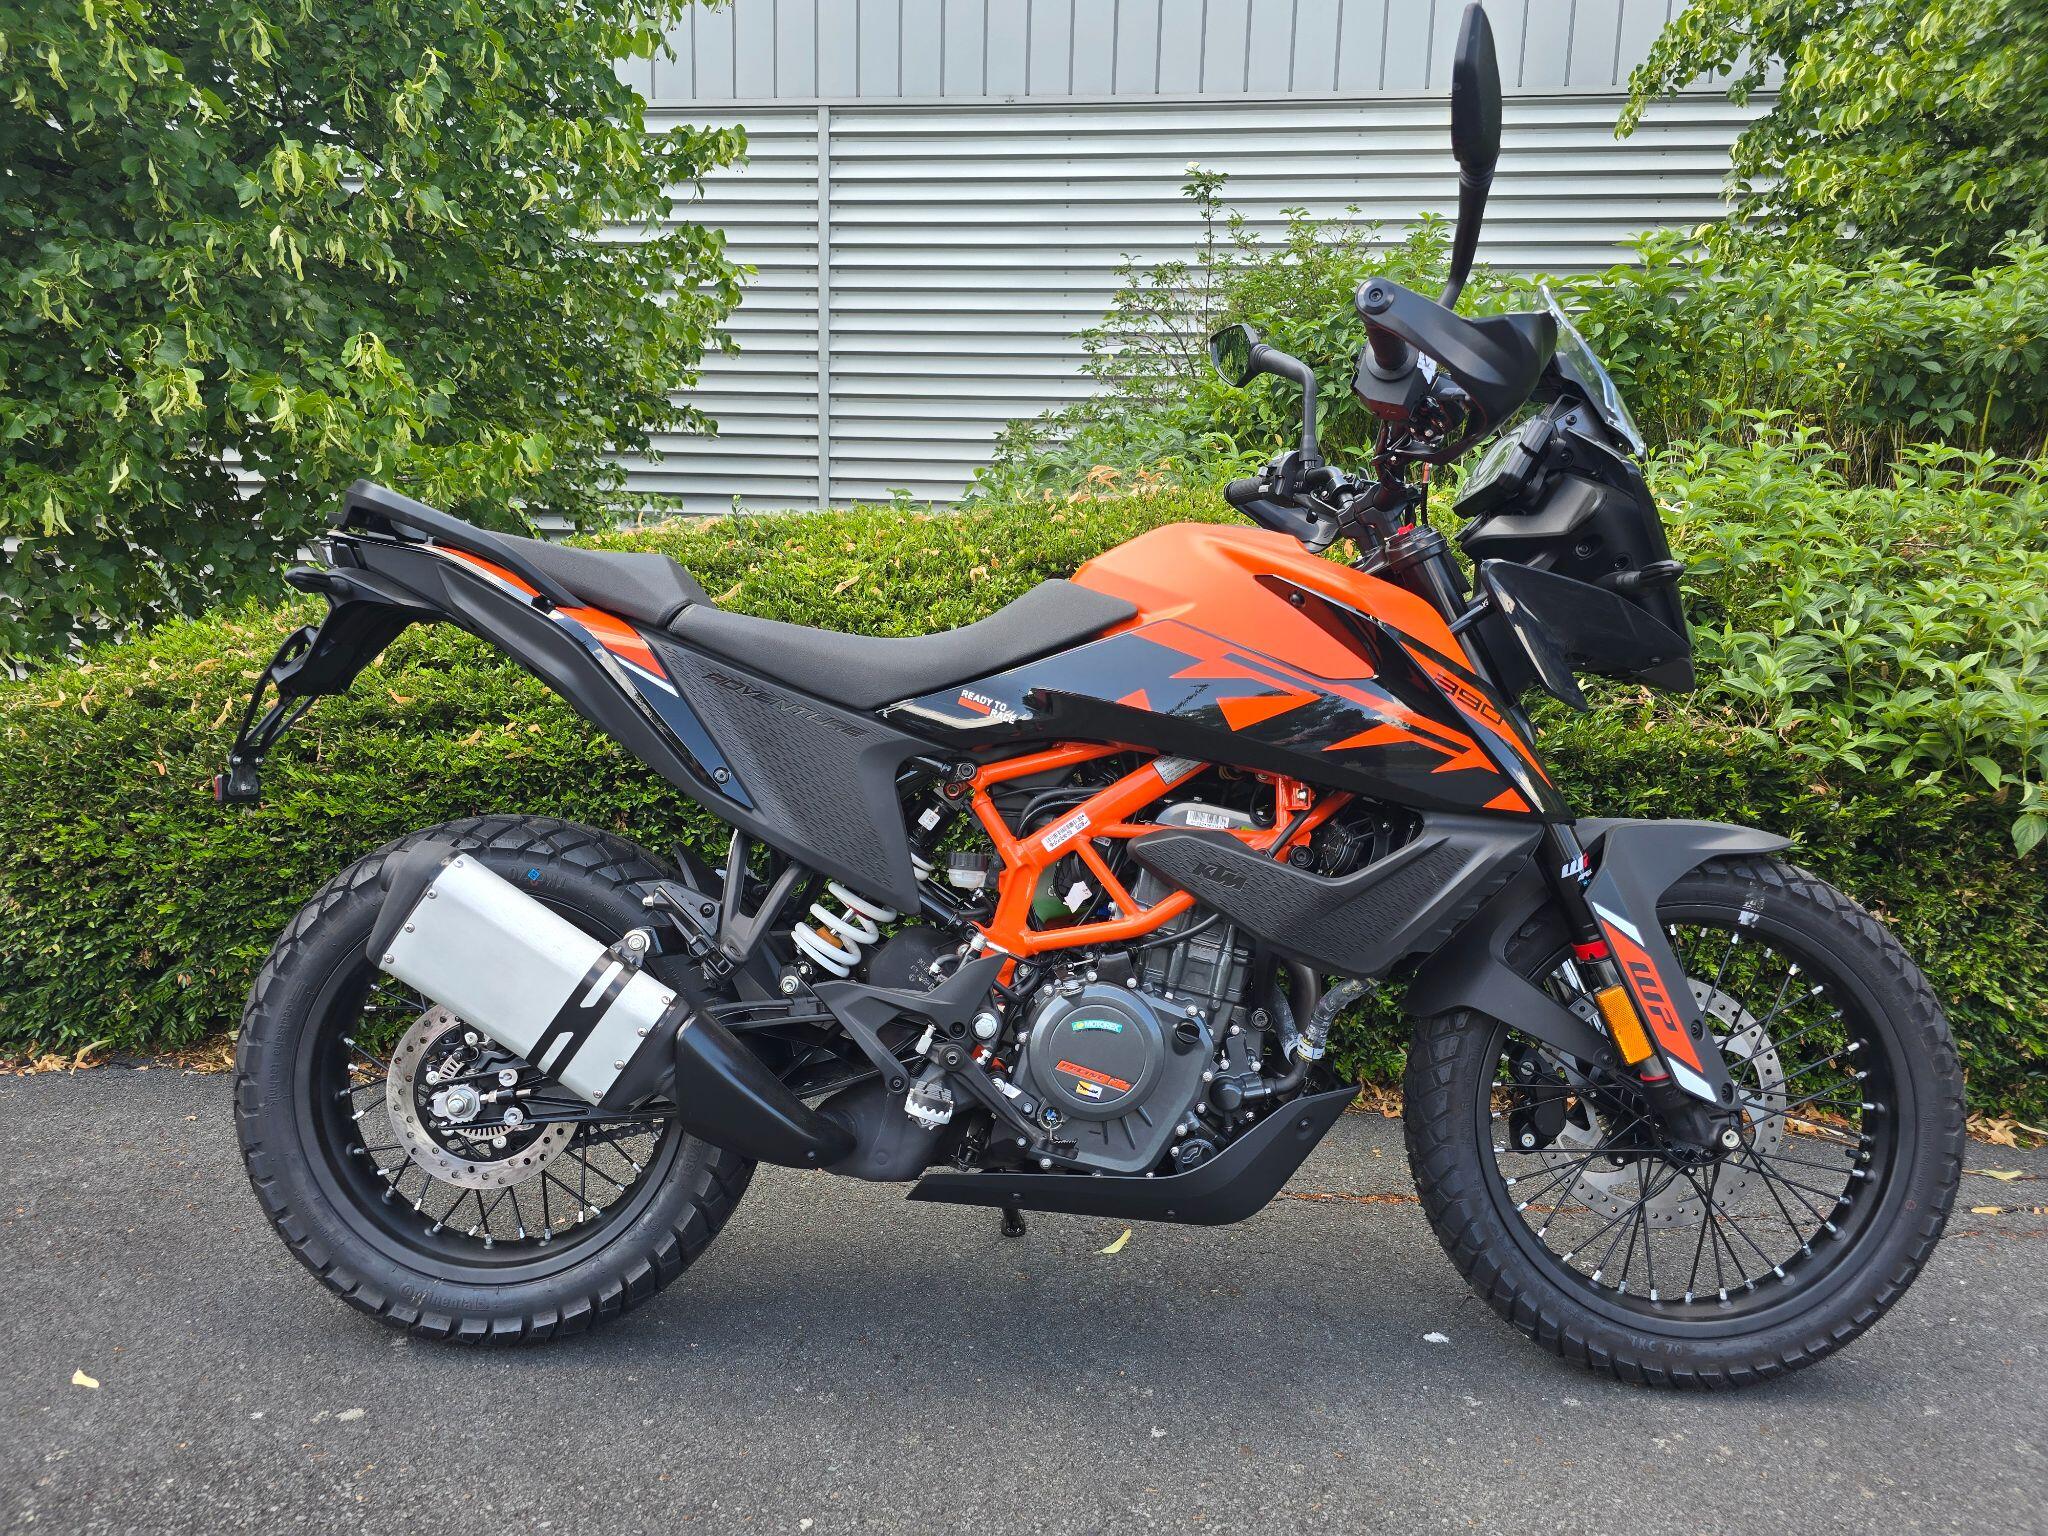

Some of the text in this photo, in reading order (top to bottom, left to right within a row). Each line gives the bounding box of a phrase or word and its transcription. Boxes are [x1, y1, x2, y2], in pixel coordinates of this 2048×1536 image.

[961, 689, 1008, 712] READY TO
[1434, 672, 1502, 725] 390
[989, 708, 1018, 725] RACE
[1192, 863, 1248, 892] KTM
